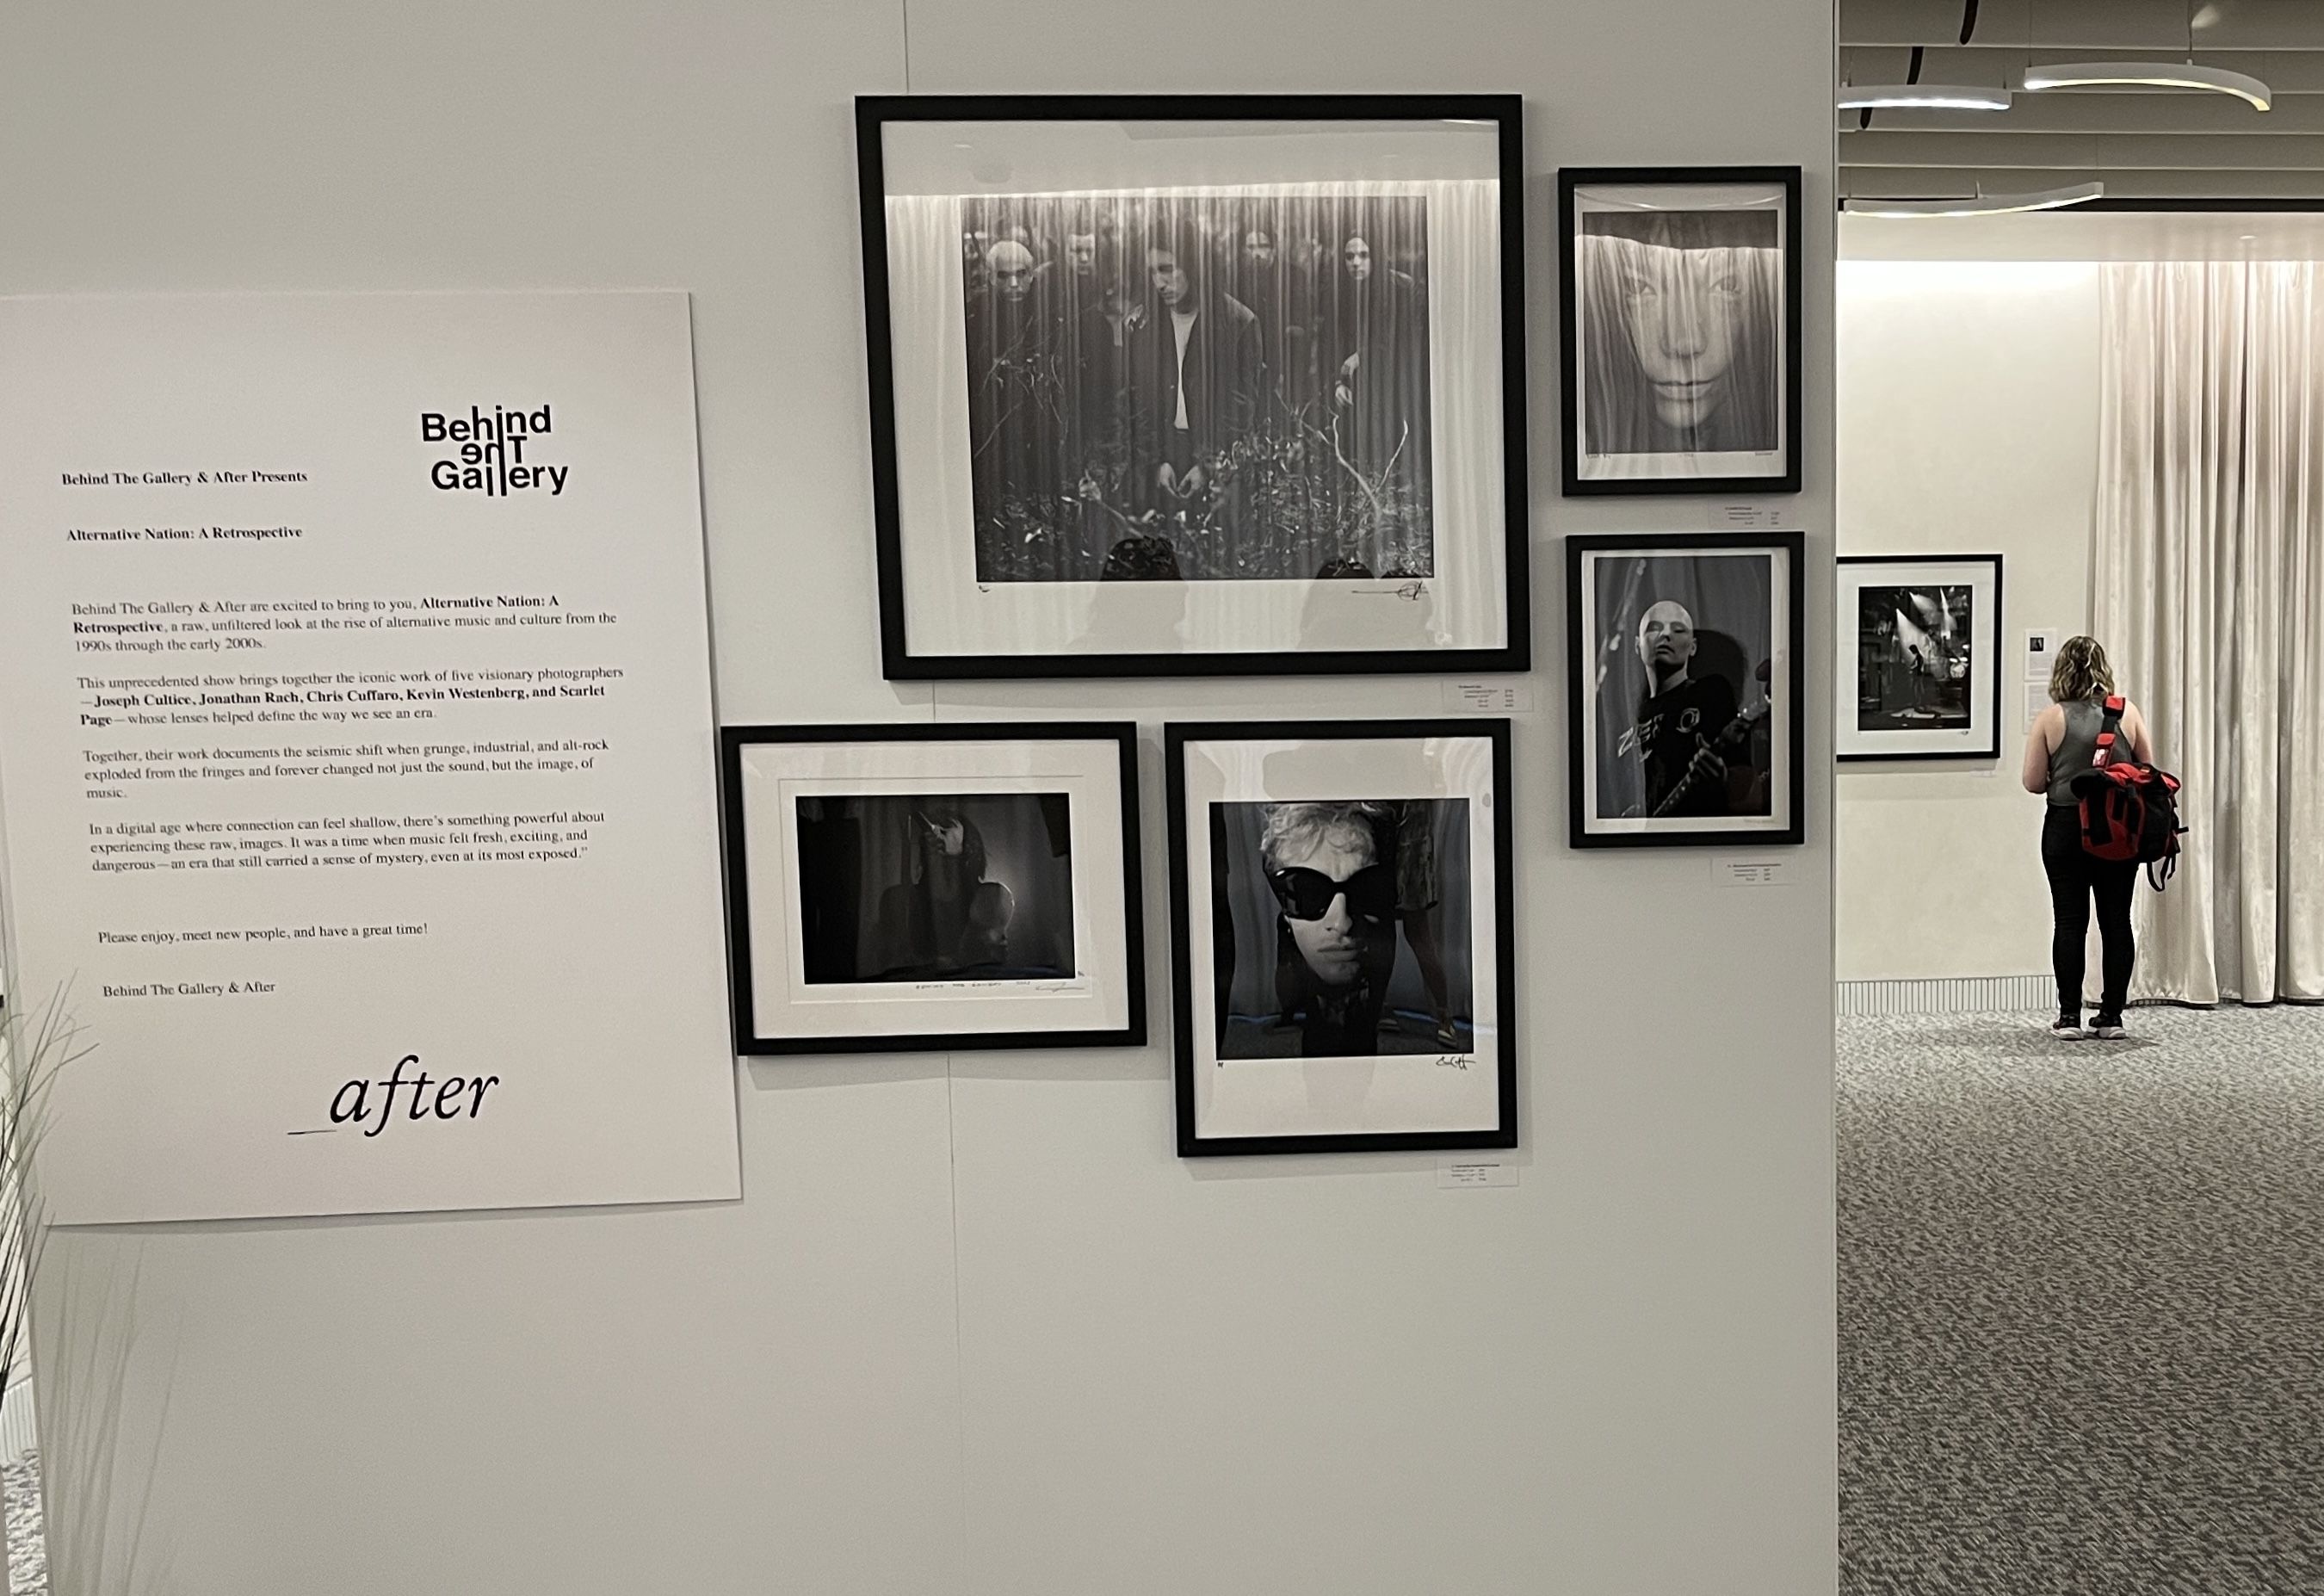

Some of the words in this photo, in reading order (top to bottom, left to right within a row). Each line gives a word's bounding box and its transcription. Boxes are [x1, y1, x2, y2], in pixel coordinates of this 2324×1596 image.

[421, 404, 552, 442] Behind
[61, 472, 109, 486] Behind
[111, 472, 139, 486] The
[142, 471, 193, 488] Gallery
[196, 471, 209, 485] &
[213, 470, 249, 484] After
[251, 469, 308, 484] Presents
[430, 460, 569, 497] Gallery
[66, 527, 141, 541] Alternative
[144, 526, 195, 540] Nation:
[198, 526, 209, 540] A
[212, 524, 303, 542] Retrospective
[71, 602, 117, 616] Behind
[119, 601, 145, 616] The
[147, 600, 195, 618] Gallery
[198, 600, 211, 614] &
[213, 599, 247, 614] After
[250, 603, 269, 613] are
[272, 597, 318, 612] excited
[321, 597, 334, 611] to
[337, 597, 370, 615] bring
[373, 597, 386, 610] to
[389, 600, 417, 613] you,
[420, 594, 494, 609] Alternative
[496, 593, 546, 608] Nation:
[548, 593, 559, 607] A
[72, 619, 169, 638] Retrospective,
[170, 622, 178, 633] a
[181, 622, 210, 634] raw,
[211, 617, 272, 632] unfiltered
[275, 616, 303, 631] look
[306, 616, 318, 630] at
[320, 616, 340, 630] the
[343, 616, 367, 629] rise
[368, 616, 384, 629] of
[386, 614, 451, 628] alternative
[454, 614, 491, 628] music
[494, 613, 516, 627] and
[519, 612, 562, 627] culture
[566, 611, 596, 626] from
[598, 611, 617, 625] the
[76, 639, 112, 653] 1990s
[114, 638, 164, 656] through
[167, 638, 187, 652] the
[189, 637, 221, 654] early
[225, 636, 266, 651] 2000s.
[76, 675, 106, 690] This
[108, 673, 200, 692] unprecedented
[202, 673, 236, 687] show
[238, 672, 279, 690] brings
[281, 671, 333, 689] together
[336, 671, 355, 684] the
[358, 670, 397, 684] iconic
[399, 669, 431, 684] work
[434, 669, 448, 683] of
[451, 668, 474, 683] five
[478, 667, 535, 685] visionary
[537, 665, 624, 684] photographers
[143, 691, 197, 708] Cultice,
[198, 690, 261, 705] Jonathan
[263, 690, 305, 705] Rach,
[306, 689, 344, 703] Chris
[346, 688, 404, 703] Cuffaro,
[405, 687, 445, 701] Kevin
[448, 685, 530, 703] Westenberg,
[531, 684, 557, 698] and
[559, 684, 605, 698] Scarlet
[82, 747, 143, 766] Together,
[145, 747, 174, 761] their
[176, 746, 209, 760] work
[212, 745, 281, 759] documents
[283, 744, 303, 758] the
[306, 743, 352, 758] seismic
[355, 742, 384, 757] shift
[386, 741, 420, 756] when
[423, 744, 471, 758] grunge,
[473, 739, 535, 755] industrial,
[537, 738, 559, 752] and
[562, 737, 609, 752] alt-rock
[83, 766, 142, 784] exploded
[145, 765, 176, 779] from
[178, 764, 199, 779] the
[201, 764, 245, 782] fringes
[248, 764, 271, 777] and
[275, 763, 319, 776] forever
[322, 761, 374, 779] changed
[376, 761, 397, 775] not
[399, 760, 423, 777] just
[425, 760, 445, 774] the
[448, 758, 490, 775] sound,
[491, 758, 511, 772] but
[515, 758, 534, 772] the
[537, 757, 578, 775] image,
[580, 757, 595, 770] of
[89, 822, 102, 836] In
[105, 826, 114, 835] a
[115, 820, 157, 838] digital
[159, 824, 182, 837] age
[185, 819, 223, 833] where
[226, 817, 294, 832] connection
[297, 820, 319, 831] can
[323, 816, 346, 830] feel
[349, 814, 401, 831] shallow,
[447, 812, 511, 830] something
[513, 810, 568, 828] powerful
[572, 809, 605, 824] about
[90, 838, 171, 857] experiencing
[173, 838, 207, 851] these
[209, 840, 238, 852] raw,
[239, 835, 287, 853] images.
[290, 835, 300, 849] It
[303, 838, 329, 849] was
[331, 838, 339, 848] a
[341, 833, 369, 848] time
[372, 832, 406, 847] when
[409, 832, 446, 846] music
[448, 831, 469, 845] felt
[473, 830, 508, 846] fresh,
[510, 829, 564, 847] exciting,
[566, 828, 588, 842] and
[189, 859, 209, 869] era
[211, 855, 235, 869] that
[238, 854, 263, 869] still
[264, 853, 308, 868] carried
[312, 857, 319, 867] a
[322, 856, 355, 866] sense
[359, 851, 374, 865] of
[375, 851, 429, 868] mystery,
[430, 853, 460, 863] even
[462, 849, 474, 863] at
[478, 849, 492, 863] its
[495, 848, 525, 862] most
[97, 930, 139, 944] Please
[140, 932, 180, 946] enjoy,
[182, 927, 213, 942] meet
[215, 931, 242, 941] new
[244, 925, 291, 943] people,
[294, 925, 316, 938] and
[318, 924, 349, 937] have
[351, 927, 359, 937] a
[362, 922, 392, 940] great
[396, 921, 428, 936] time!
